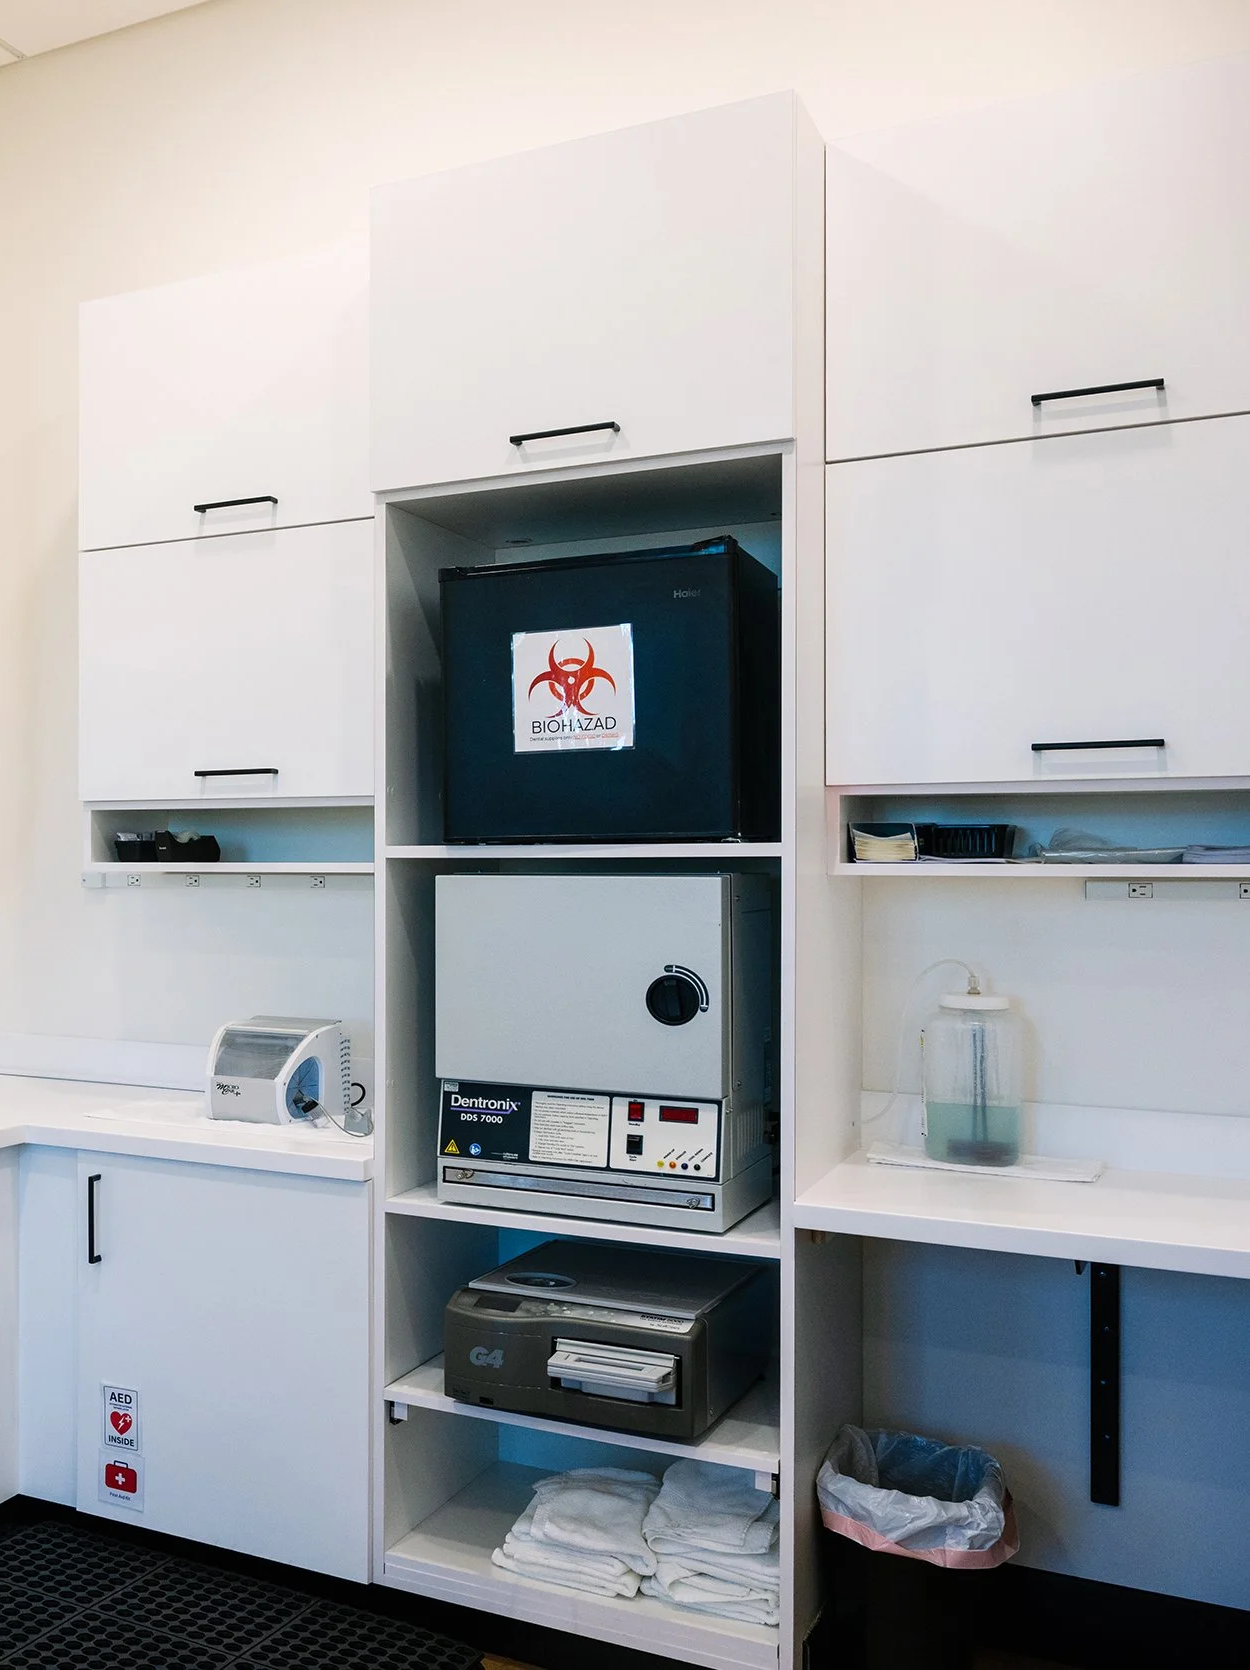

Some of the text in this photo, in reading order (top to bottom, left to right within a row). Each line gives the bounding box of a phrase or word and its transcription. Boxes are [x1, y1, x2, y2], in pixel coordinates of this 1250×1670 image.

[532, 716, 617, 734] BIOHAZAD
[451, 1094, 518, 1111] Dentronix
[461, 1113, 503, 1124] DDS 7000
[469, 1346, 504, 1368] G4
[110, 1391, 132, 1405] AED
[109, 1435, 134, 1447] INSIDE
